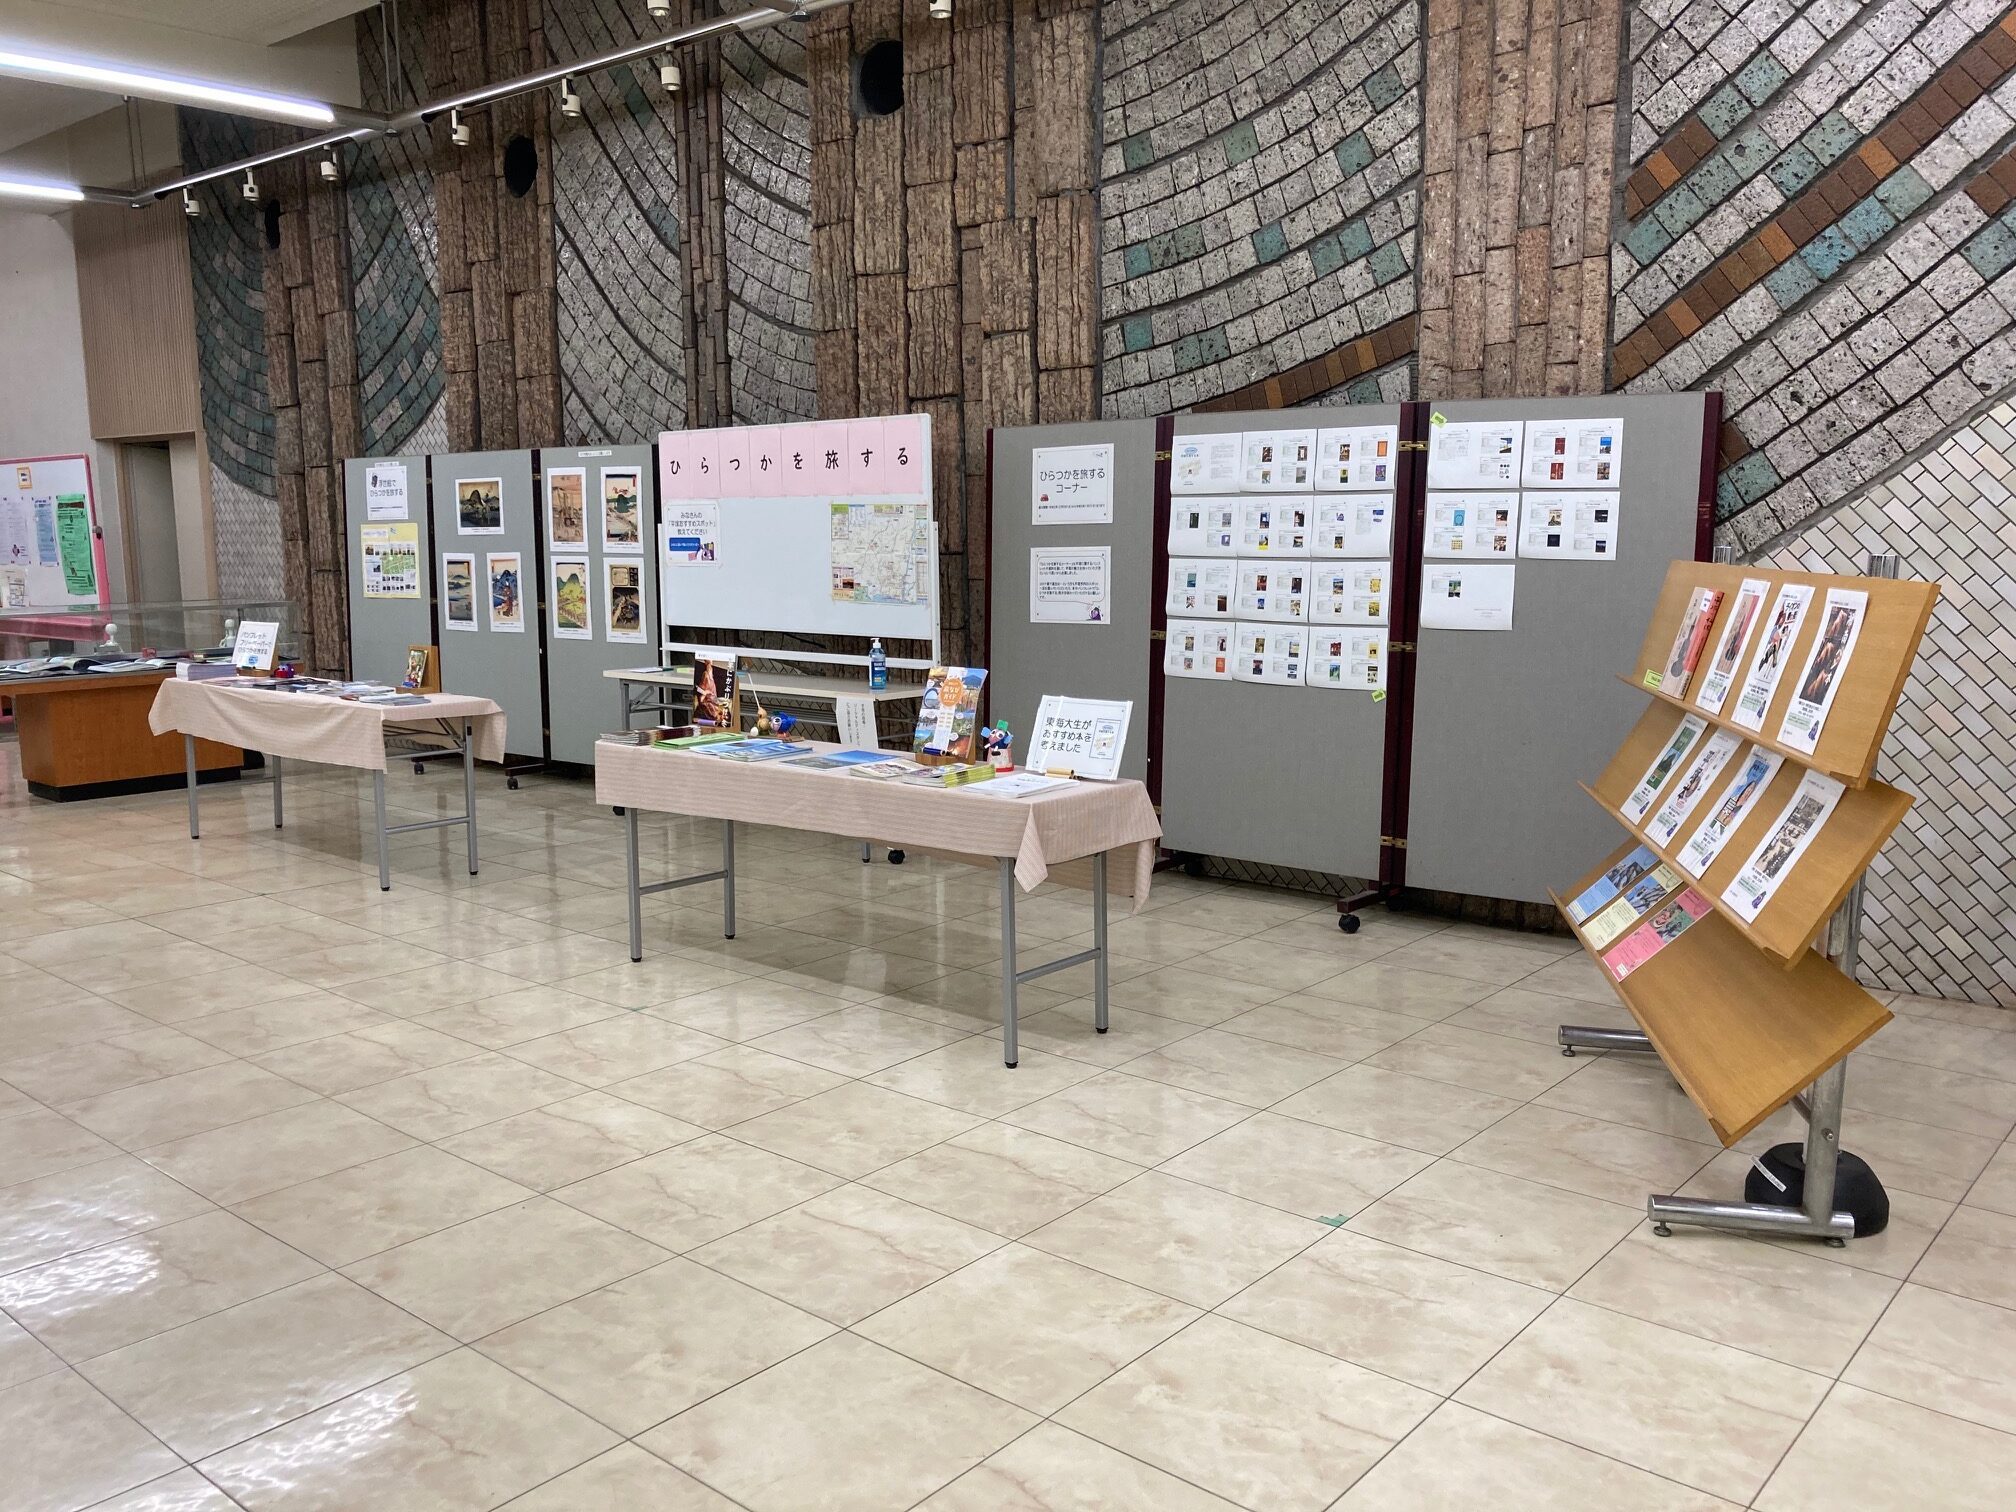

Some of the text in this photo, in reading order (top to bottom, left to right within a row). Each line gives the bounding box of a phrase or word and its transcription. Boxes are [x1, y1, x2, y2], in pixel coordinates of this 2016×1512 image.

[670, 447, 909, 475] ひらつかを旅する
[1040, 468, 1106, 482] ひらつかを旅する
[1056, 482, 1088, 494] コーナー
[680, 511, 703, 519] みなさんの
[1046, 716, 1093, 730] 東海大生が
[1042, 729, 1093, 743] おすすめ本を
[1040, 740, 1081, 753] 考えました
